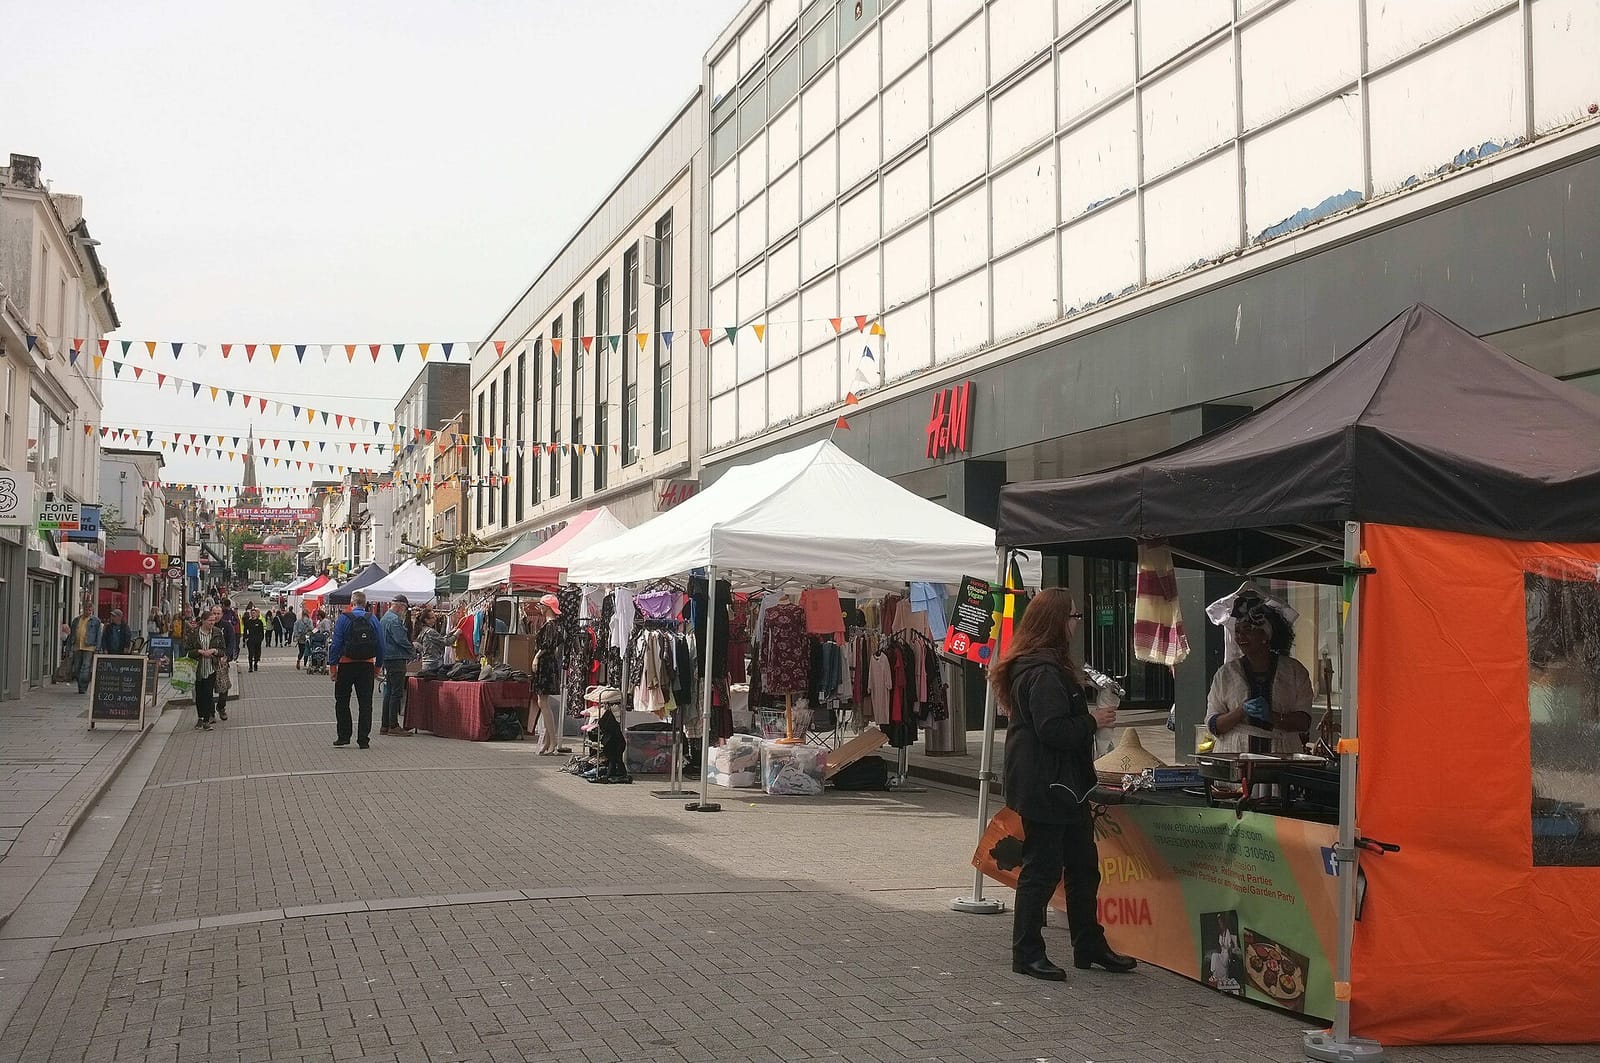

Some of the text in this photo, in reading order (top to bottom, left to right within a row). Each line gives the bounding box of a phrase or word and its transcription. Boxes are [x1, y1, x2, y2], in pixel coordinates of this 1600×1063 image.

[925, 380, 971, 459] H&M
[40, 513, 78, 522] REVIVE
[170, 557, 181, 565] JD
[953, 640, 966, 651] £5
[1243, 845, 1275, 862] 310569
[1247, 873, 1273, 886] Parties
[1277, 890, 1296, 904] Party
